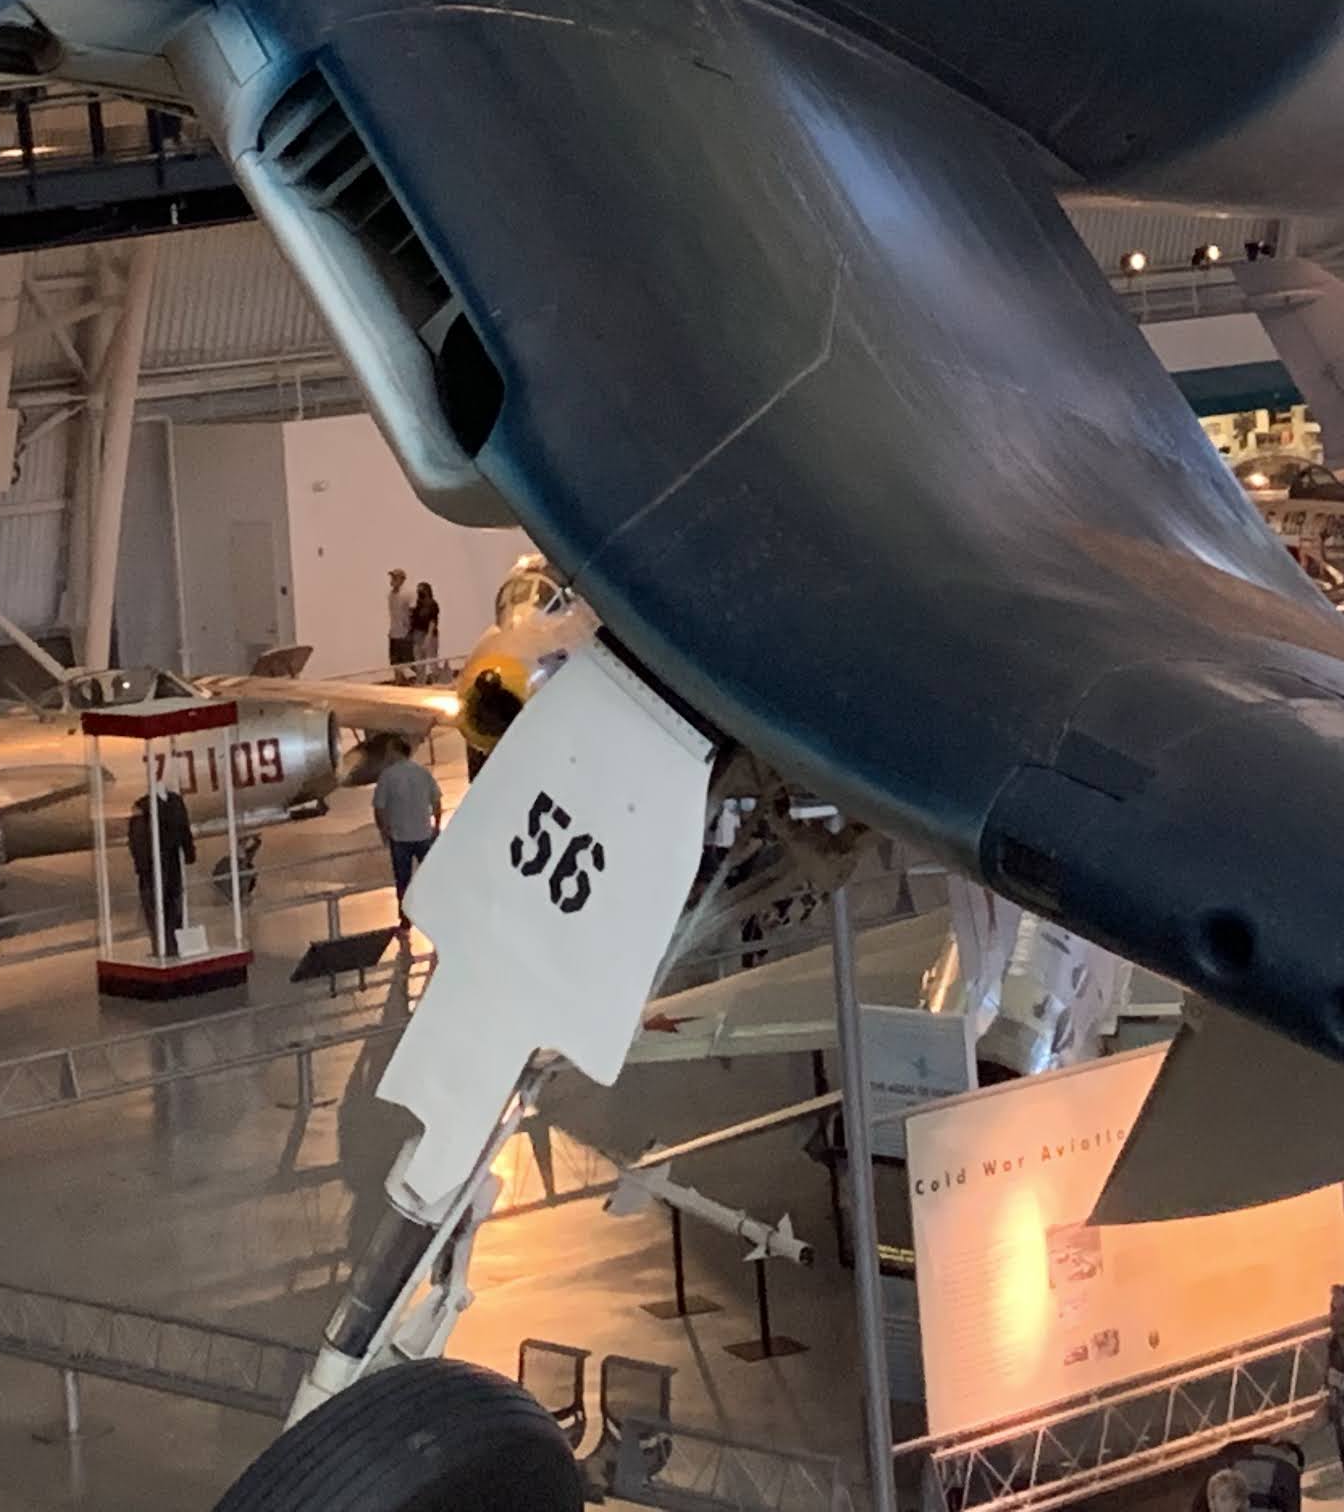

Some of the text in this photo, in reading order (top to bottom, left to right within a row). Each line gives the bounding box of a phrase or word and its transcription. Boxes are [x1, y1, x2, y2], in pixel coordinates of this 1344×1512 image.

[510, 791, 605, 914] 56
[915, 1128, 1126, 1195] Cold War Aviatio
